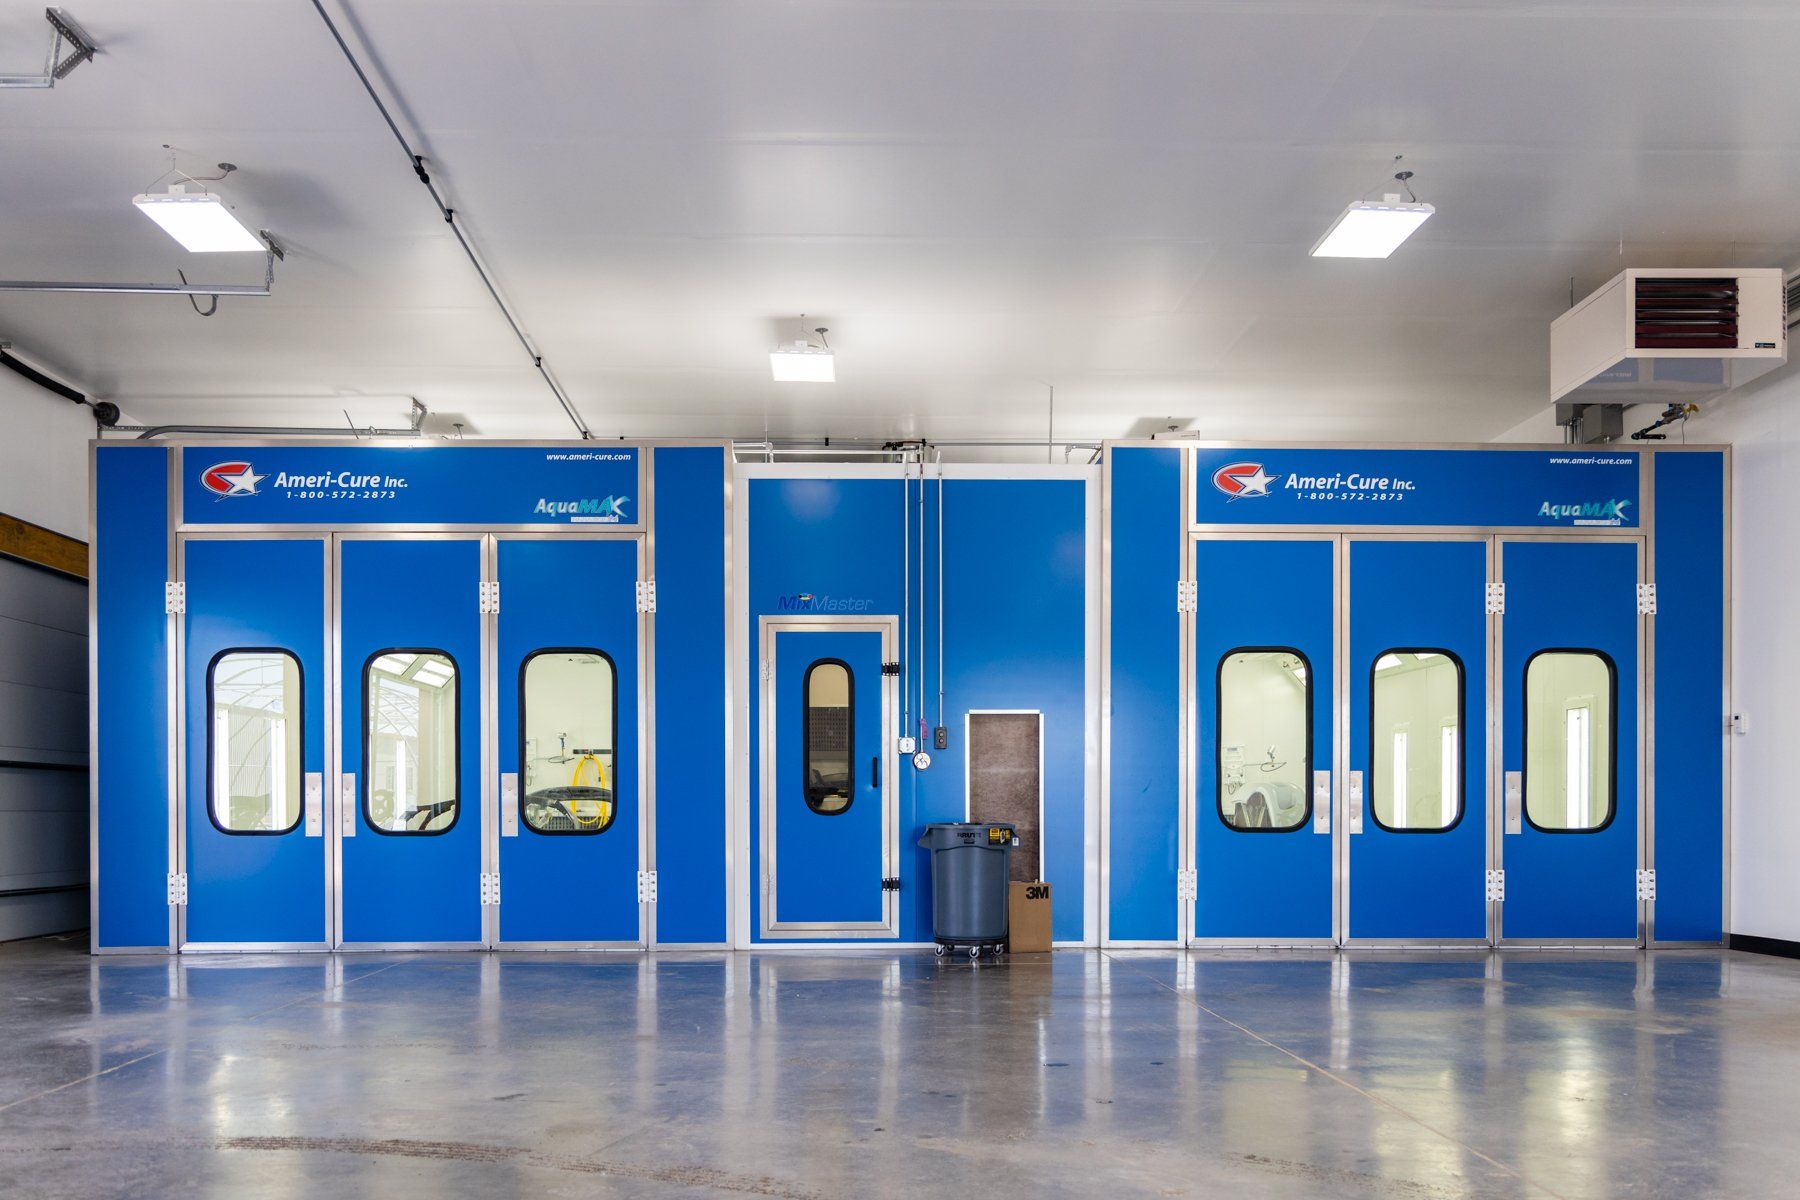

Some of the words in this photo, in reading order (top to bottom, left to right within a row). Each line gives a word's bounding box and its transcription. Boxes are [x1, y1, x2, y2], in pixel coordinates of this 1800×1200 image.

[546, 453, 631, 461] www.ameri-cure.com
[1549, 457, 1633, 465] www.ameri-cure.com
[274, 471, 380, 488] Ameri-Cure
[384, 475, 408, 488] Inc.
[1285, 473, 1389, 490] Ameri-Cure
[1392, 478, 1416, 490] Inc.
[286, 491, 395, 499] 1-800-572-2873
[1297, 492, 1403, 501] 1-800-572-2873
[777, 593, 873, 611] MixMaster
[1026, 886, 1049, 899] 3M
